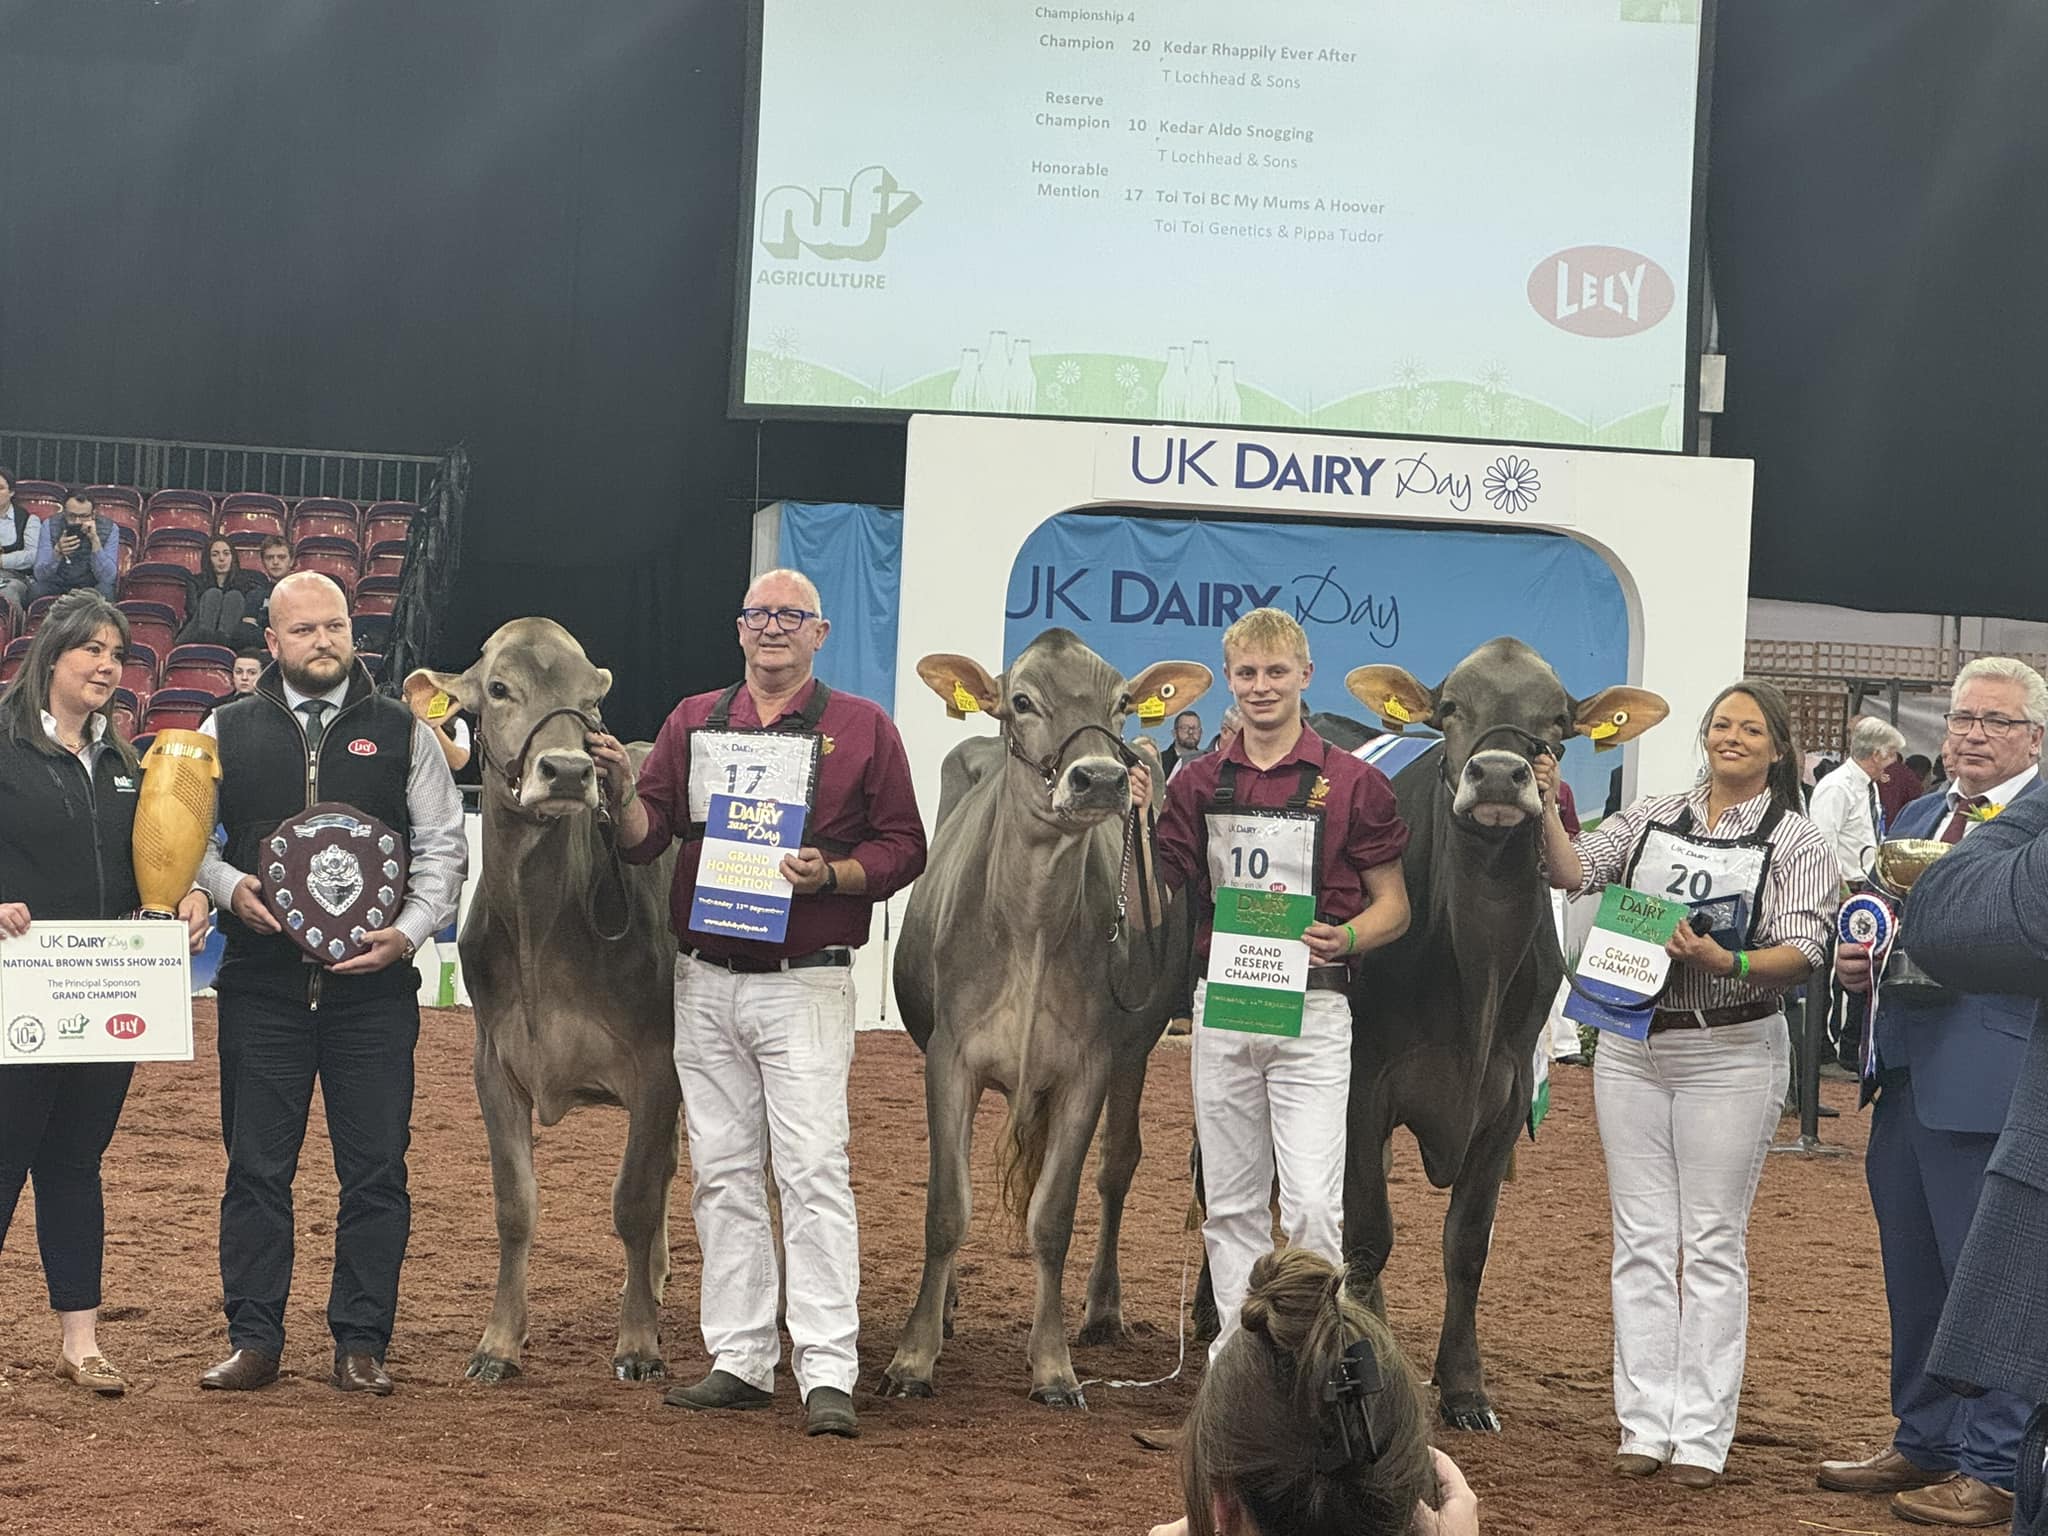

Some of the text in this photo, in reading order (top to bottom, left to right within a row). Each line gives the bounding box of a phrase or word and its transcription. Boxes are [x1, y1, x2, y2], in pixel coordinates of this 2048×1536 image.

[1035, 6, 1136, 24] Championship 4
[1039, 34, 1151, 52] Champion 20
[1163, 41, 1357, 63] Kedar Rhappily Ever After
[1162, 70, 1301, 88] T Lochhead & Sons
[1045, 91, 1105, 105] Reserve
[1035, 113, 1147, 131] Champion 10
[1159, 120, 1314, 143] Kedar Aldo Snogging
[1158, 149, 1298, 168] T Lochhead & Sons
[1031, 160, 1109, 176] Honorable
[1037, 184, 1143, 201] Mention 17
[1156, 190, 1385, 214] Toi Toi BC My Mums A Hoover
[1155, 219, 1384, 243] Toi Toi Genetics & Pippa Tudor
[756, 269, 886, 289] AGRICULTURE
[1557, 260, 1648, 321] LELY
[1131, 435, 1472, 511] UK DAIRY Day
[1291, 564, 1400, 649] Day
[724, 764, 767, 794] 17
[728, 800, 784, 826] DAIRY
[728, 850, 770, 865] GRAND
[1231, 847, 1269, 880] 10
[717, 874, 773, 891] MENTION
[1665, 863, 1713, 901] 20
[1619, 893, 1667, 921] DAIRY
[40, 934, 64, 949] UK
[67, 934, 106, 948] DAIRY
[1239, 944, 1282, 958] GRAND
[1604, 946, 1650, 969] GRAND
[3, 957, 182, 968] NATIONAL BROWN SWISS SHOW 2024
[1234, 956, 1285, 971] RESERVE
[1588, 955, 1659, 985] CHAMPION
[47, 978, 141, 989] The Principal Sponsors
[1224, 968, 1290, 985] CHAMPION
[52, 990, 137, 1000] GRAND CHAMPION
